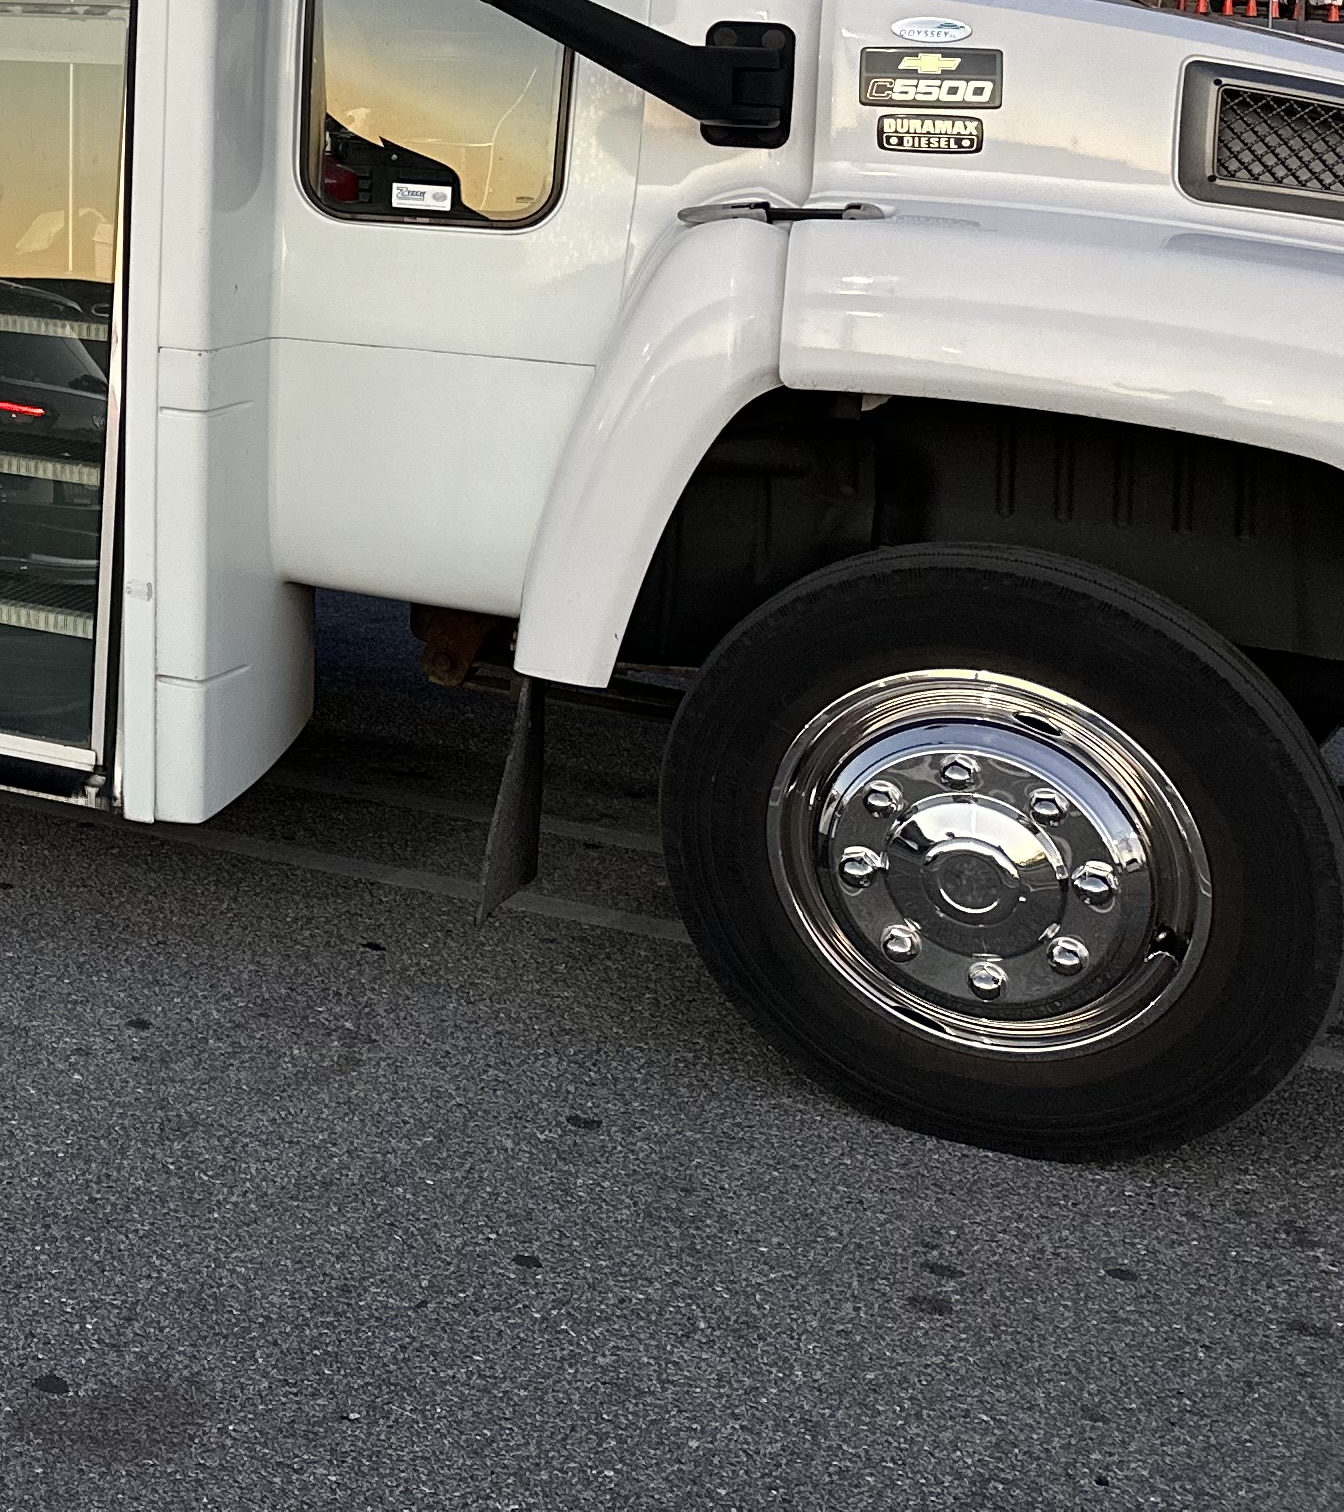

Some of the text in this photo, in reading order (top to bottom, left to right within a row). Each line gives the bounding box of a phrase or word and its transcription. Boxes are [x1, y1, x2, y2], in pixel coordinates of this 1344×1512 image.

[867, 78, 994, 102] C5500
[884, 118, 978, 135] DURAMAX
[903, 136, 958, 149] DIESEL
